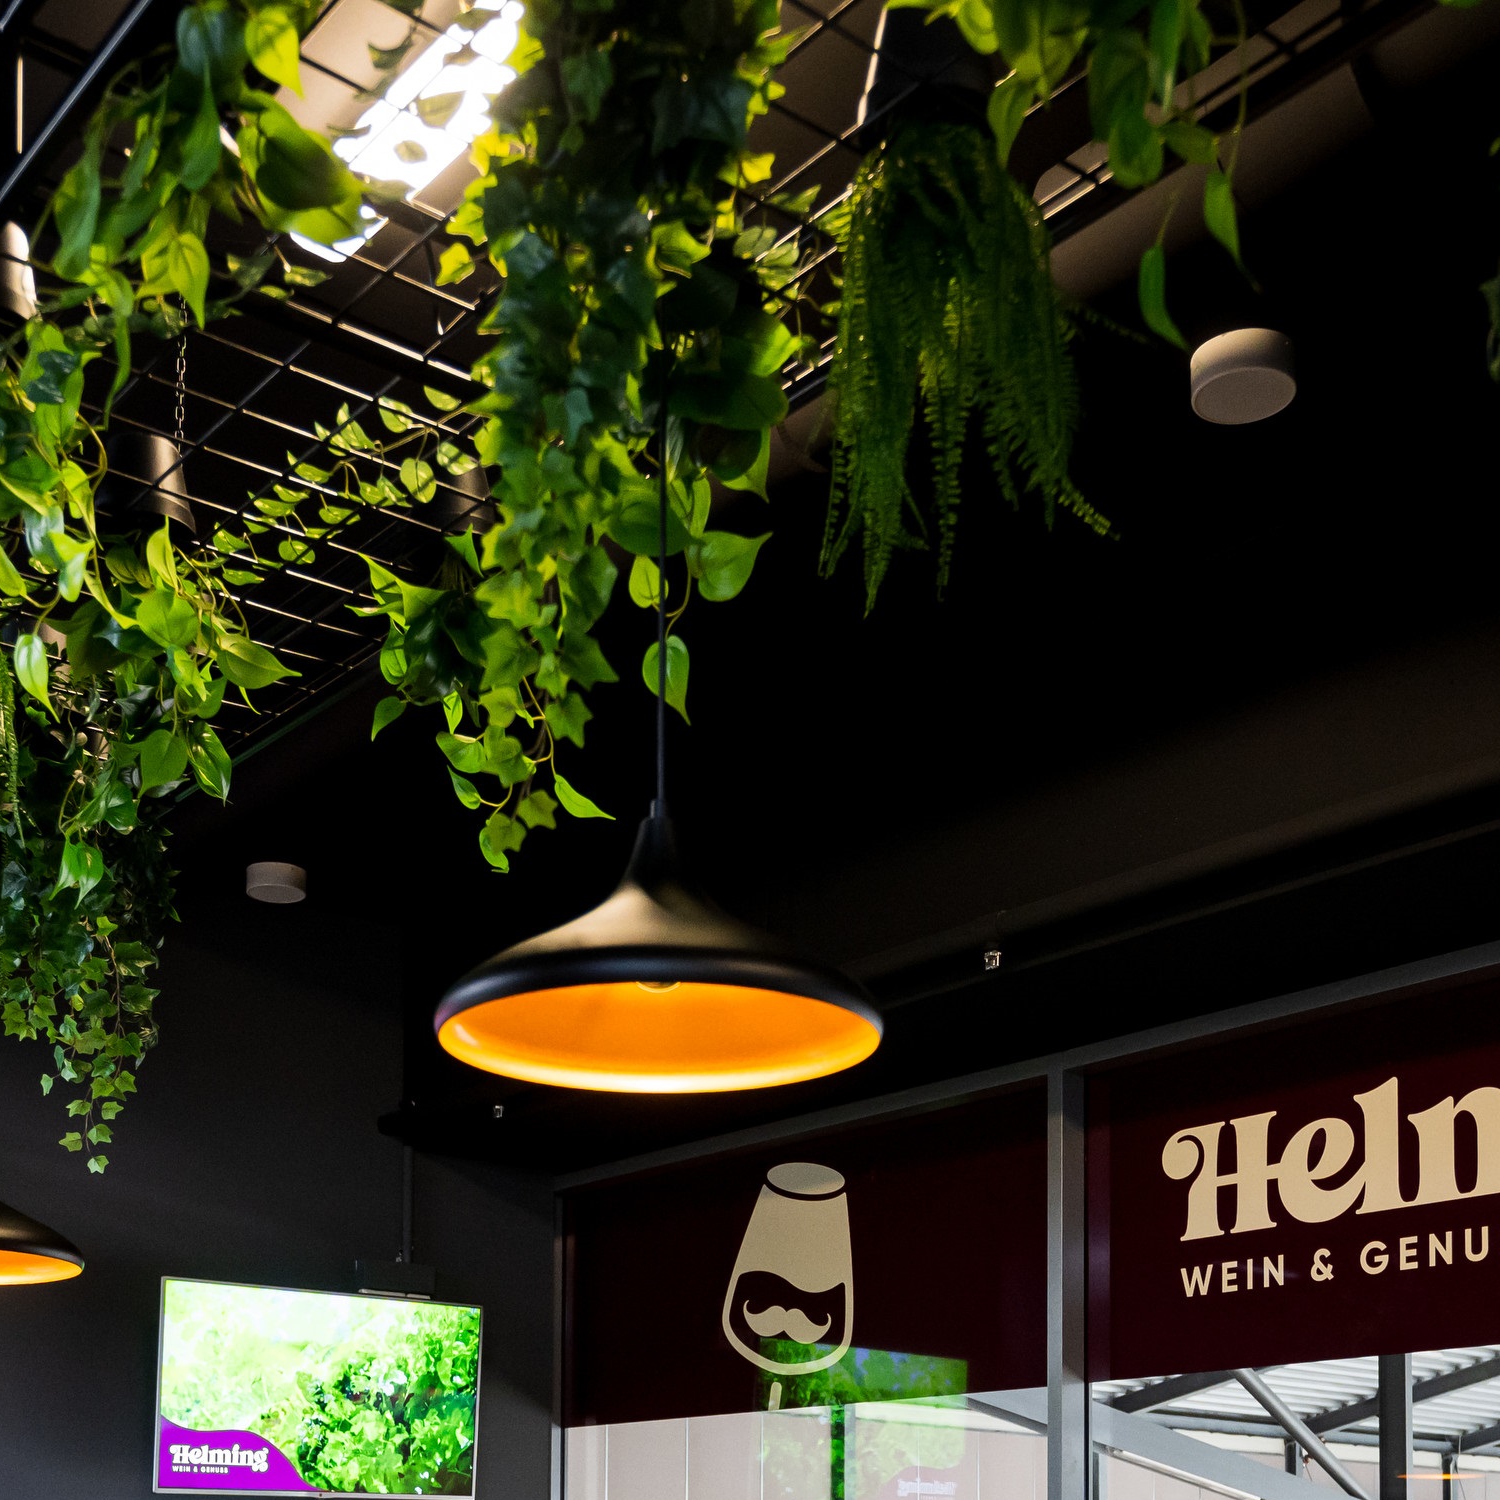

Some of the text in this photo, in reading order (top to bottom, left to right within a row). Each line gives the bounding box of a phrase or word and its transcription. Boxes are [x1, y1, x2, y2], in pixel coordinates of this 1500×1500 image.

[1180, 1254, 1285, 1298] WEIN
[1310, 1248, 1335, 1282] &
[169, 1443, 270, 1473] Helming
